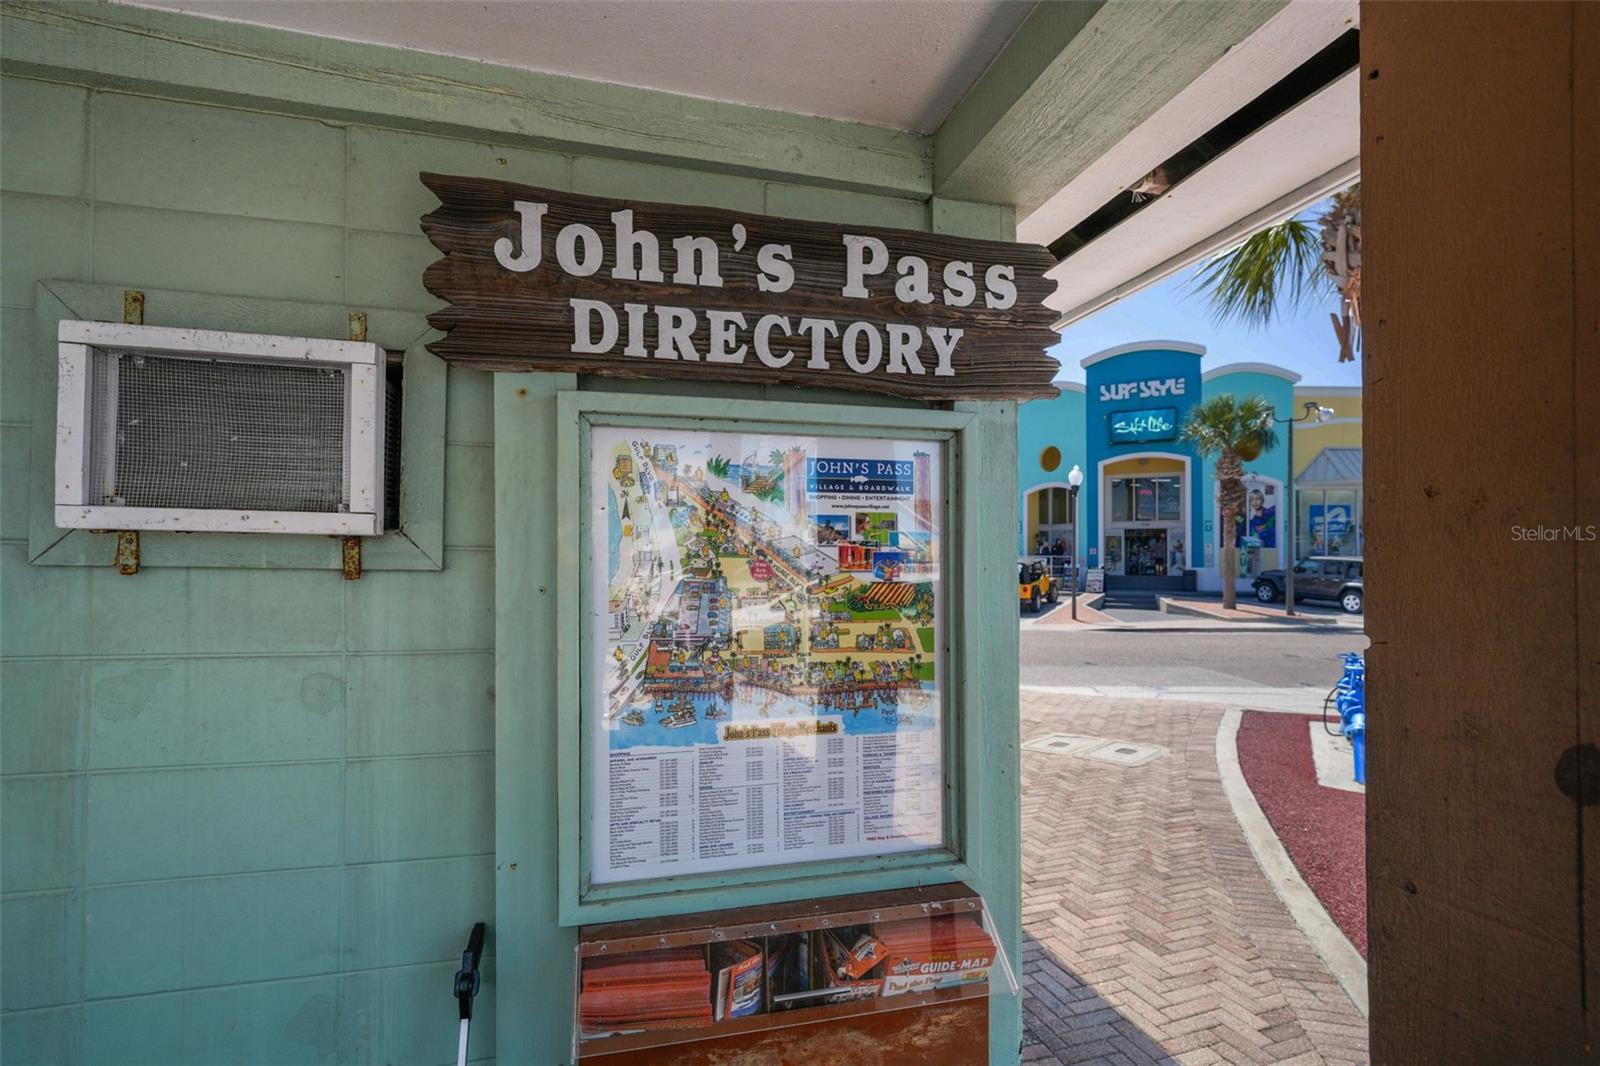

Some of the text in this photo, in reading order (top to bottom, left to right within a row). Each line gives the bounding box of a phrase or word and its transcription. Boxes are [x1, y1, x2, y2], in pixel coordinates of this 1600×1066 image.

[493, 200, 1018, 310] John's Pass
[569, 297, 964, 377] DIRECTORY
[809, 460, 912, 476] JOHN'S PASS
[920, 957, 989, 974] GUIDE-MAP
